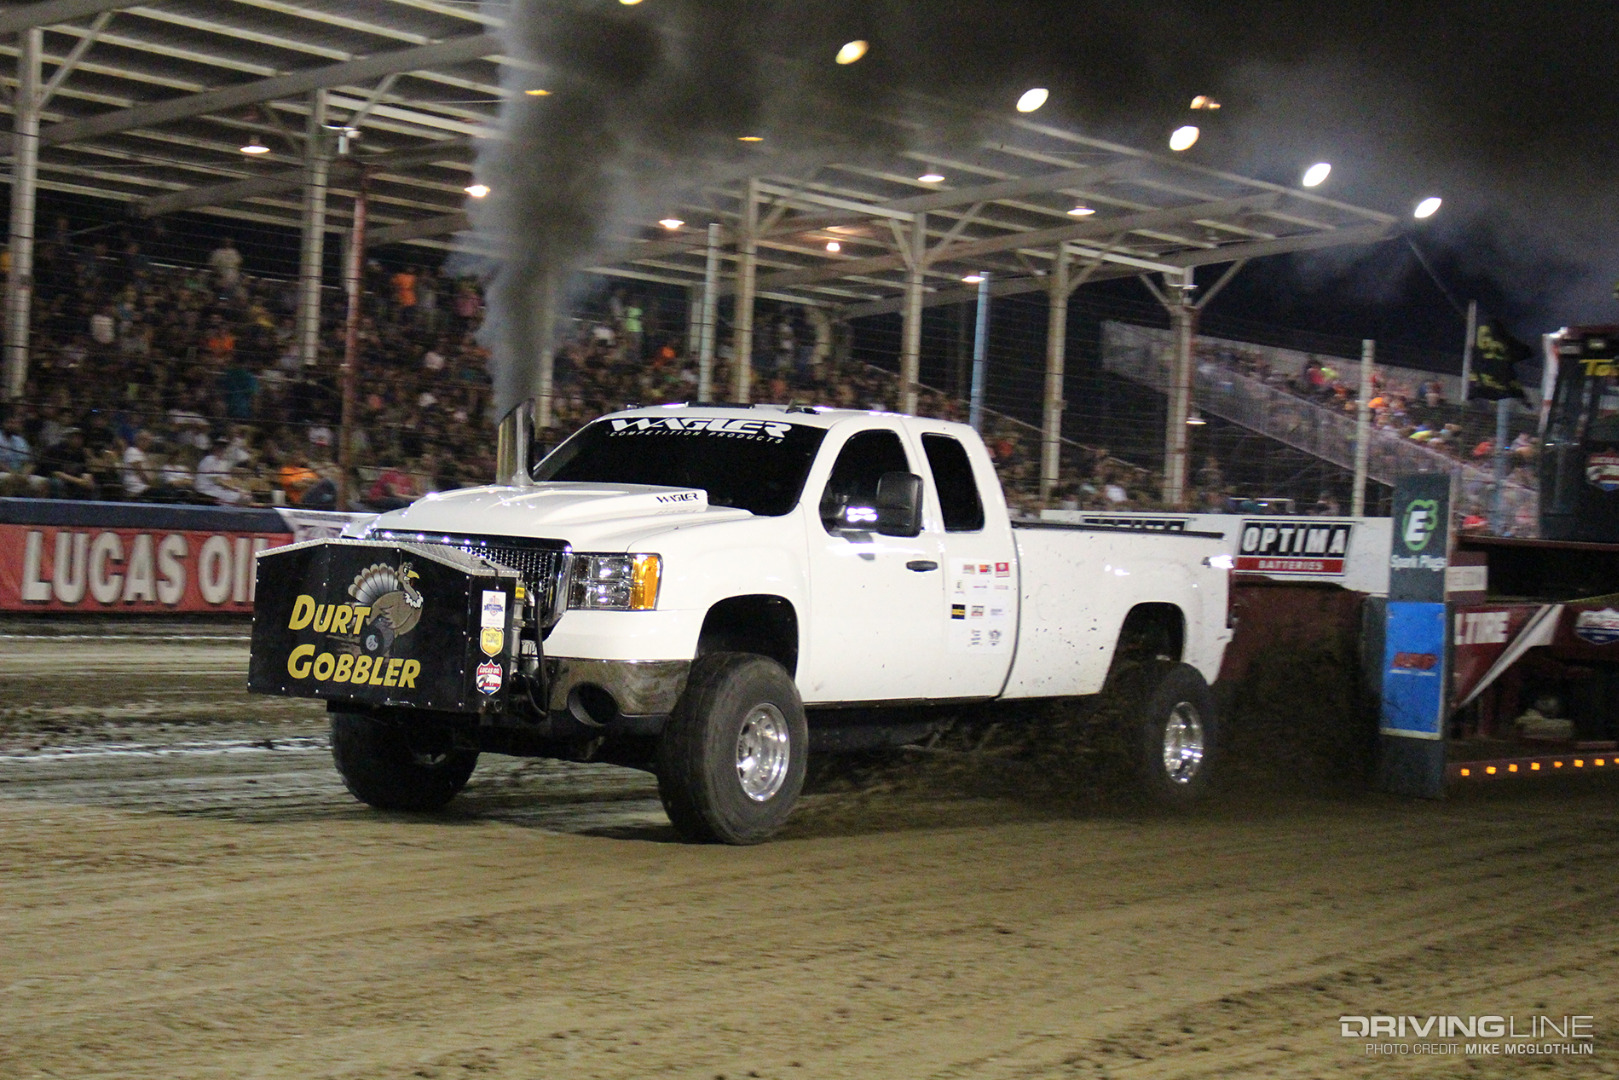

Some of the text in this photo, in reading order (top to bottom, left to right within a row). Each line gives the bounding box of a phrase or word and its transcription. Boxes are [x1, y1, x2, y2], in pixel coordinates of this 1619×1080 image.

[609, 429, 784, 444] COMPETITION PRODUCTS
[611, 417, 792, 438] WAGLER
[656, 492, 699, 504] WAGLER
[1242, 526, 1347, 553] OPTIMA
[21, 531, 189, 605] LUCAS
[1258, 560, 1325, 571] BATTERIES
[288, 594, 372, 635] DURT
[287, 643, 421, 689] GOBBLER
